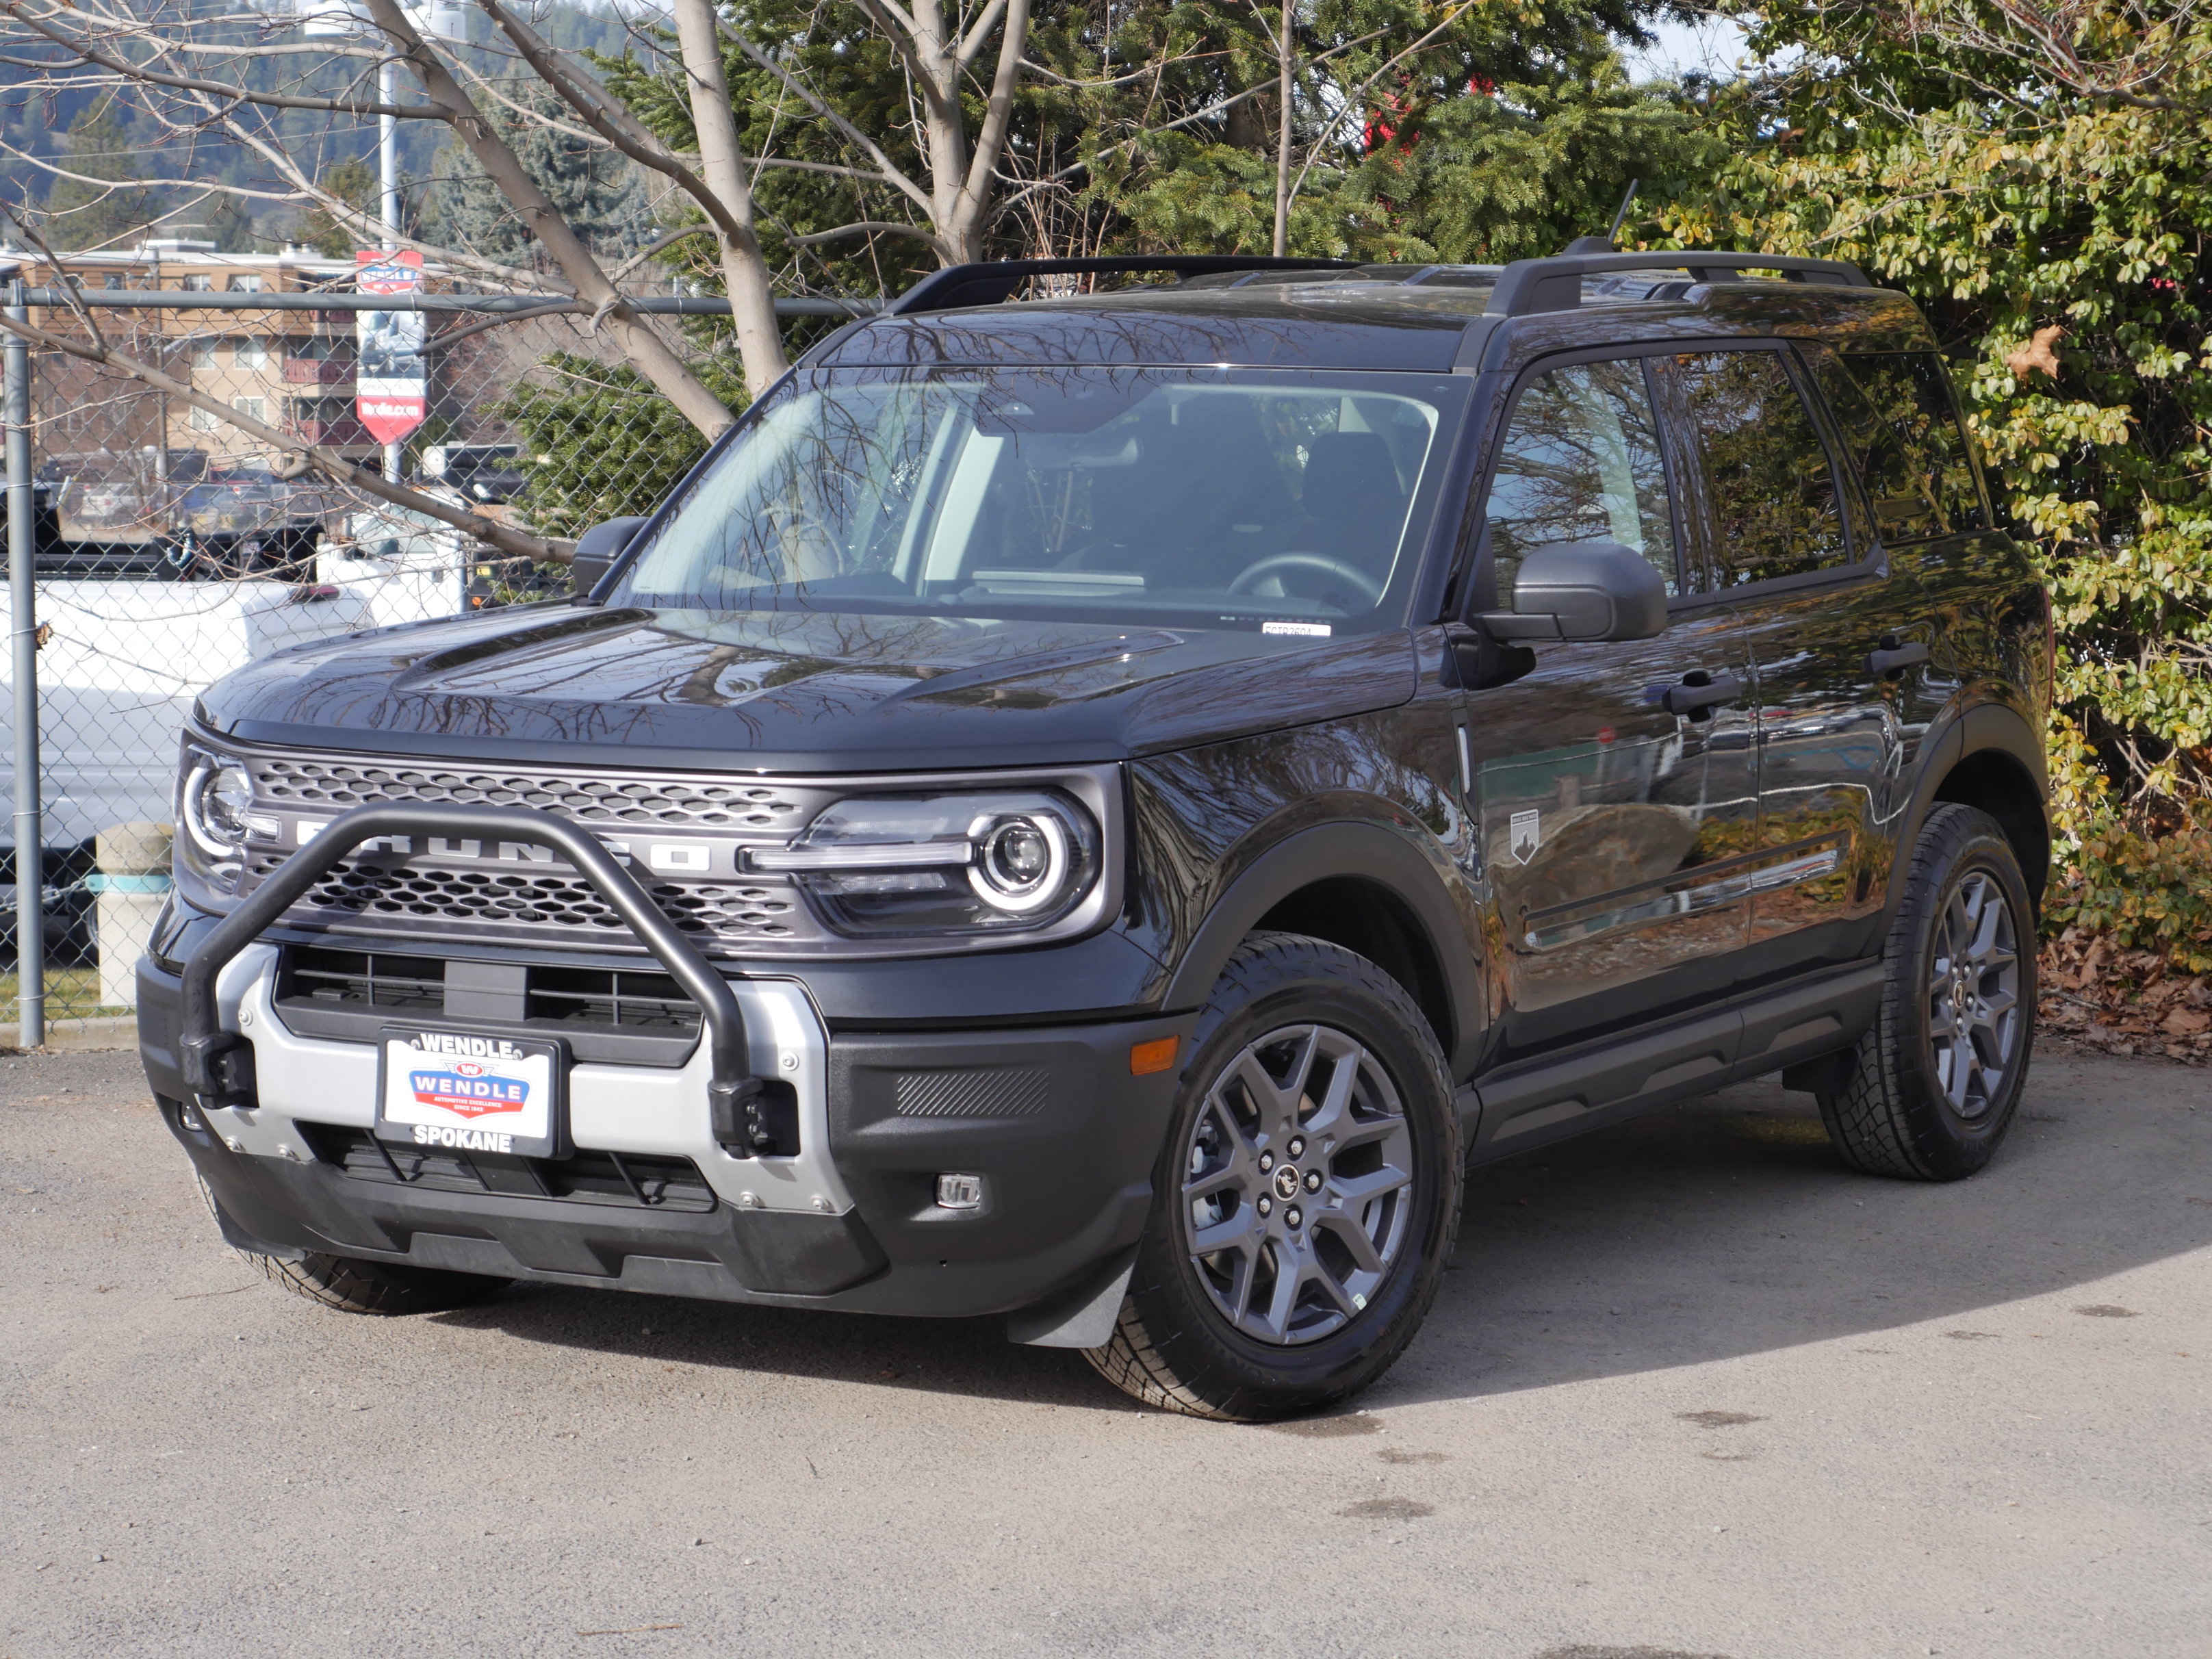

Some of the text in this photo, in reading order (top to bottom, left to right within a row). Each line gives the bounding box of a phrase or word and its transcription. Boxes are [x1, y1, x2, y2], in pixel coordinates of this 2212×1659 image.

[420, 1033, 513, 1059] WENDLE
[414, 1076, 521, 1099] WENDLE
[434, 1096, 502, 1108] AUTOMOTIVE EXCELLENCE
[415, 1125, 511, 1153] SPOKANE
